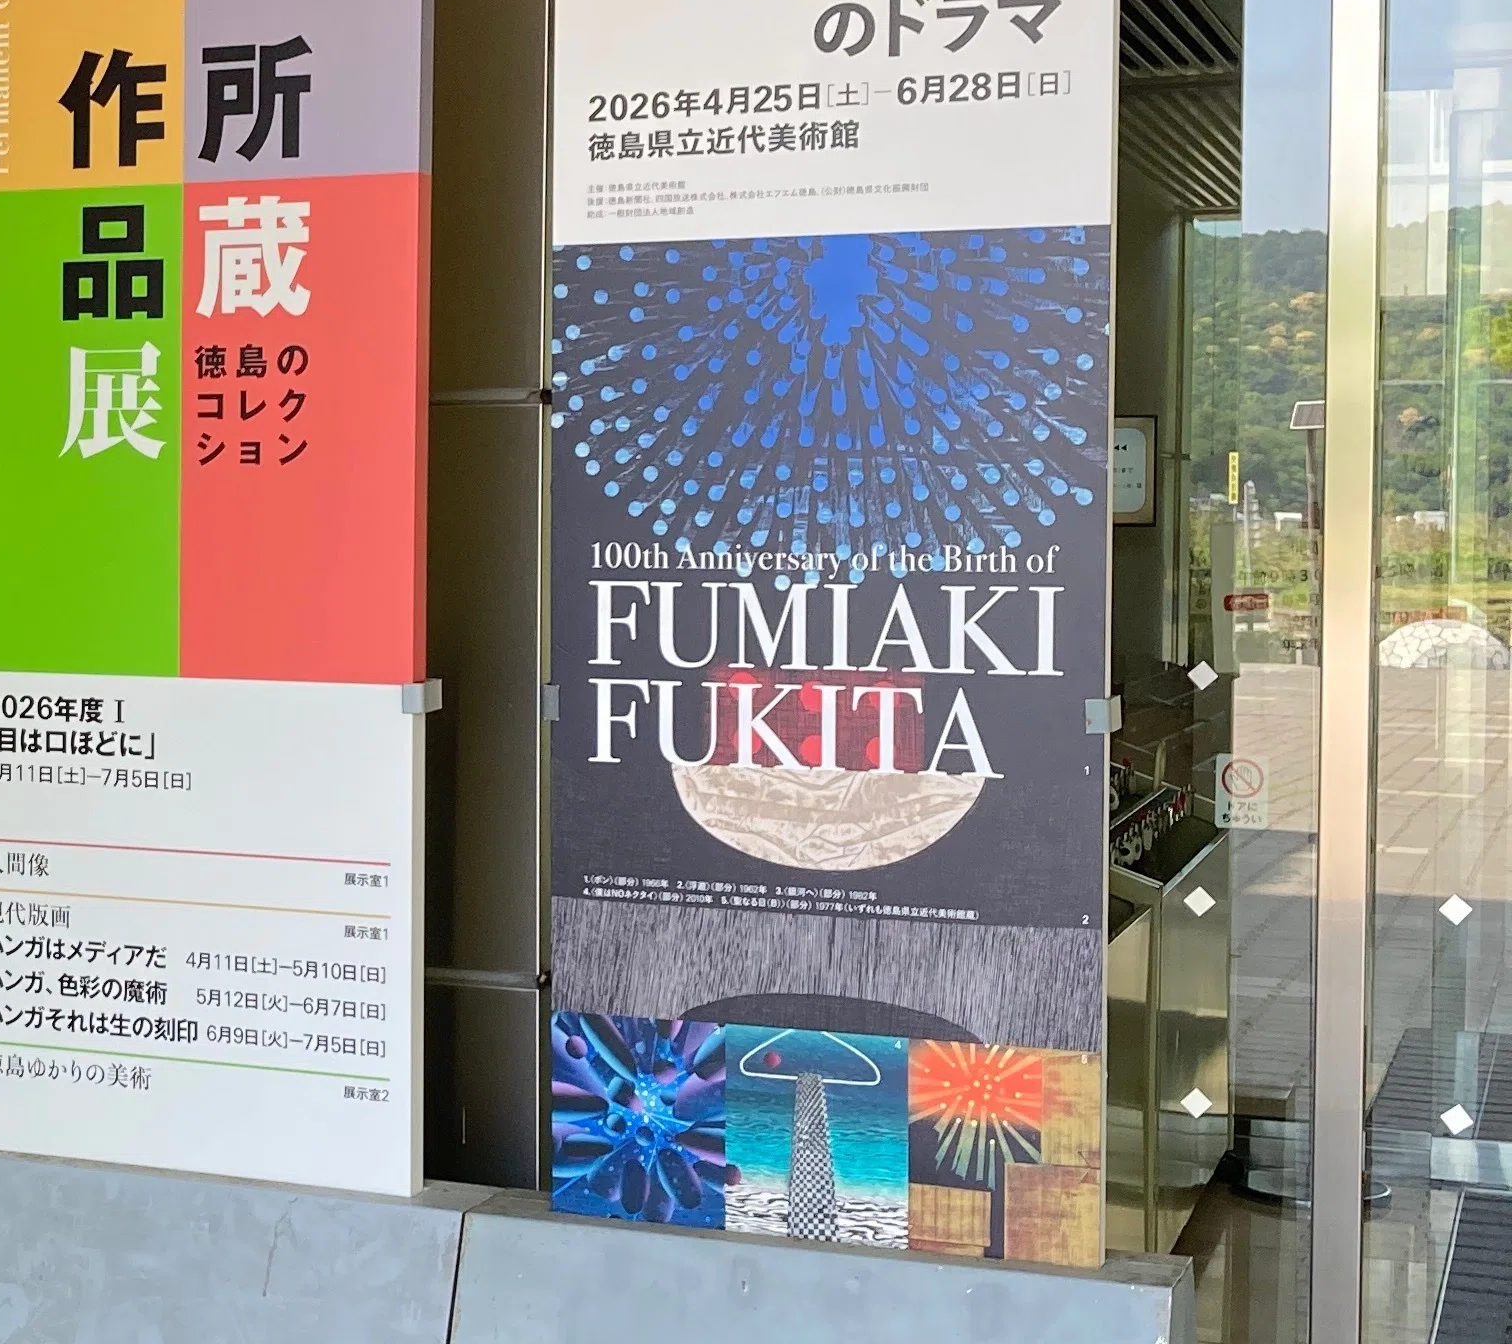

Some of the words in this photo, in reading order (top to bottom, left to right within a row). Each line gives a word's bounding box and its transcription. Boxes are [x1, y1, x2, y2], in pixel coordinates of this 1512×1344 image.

[587, 118, 860, 163] 徳島県立近代美術館
[195, 344, 308, 379] 徳島の
[197, 389, 306, 422] コレク
[198, 432, 308, 466] ション
[590, 541, 670, 570] 100th
[676, 543, 844, 580] Anniversary
[851, 544, 883, 573] of
[889, 544, 934, 574] the
[944, 544, 1020, 574] Birth
[1026, 545, 1060, 575] of
[588, 580, 1065, 677] FUMIAKI
[588, 678, 1005, 779] FUKITA
[1084, 765, 1089, 775] 1
[344, 873, 389, 888] 展示室1
[344, 925, 389, 941] 展示室1
[1082, 914, 1089, 925] 2
[344, 1086, 390, 1102] 展示室2
